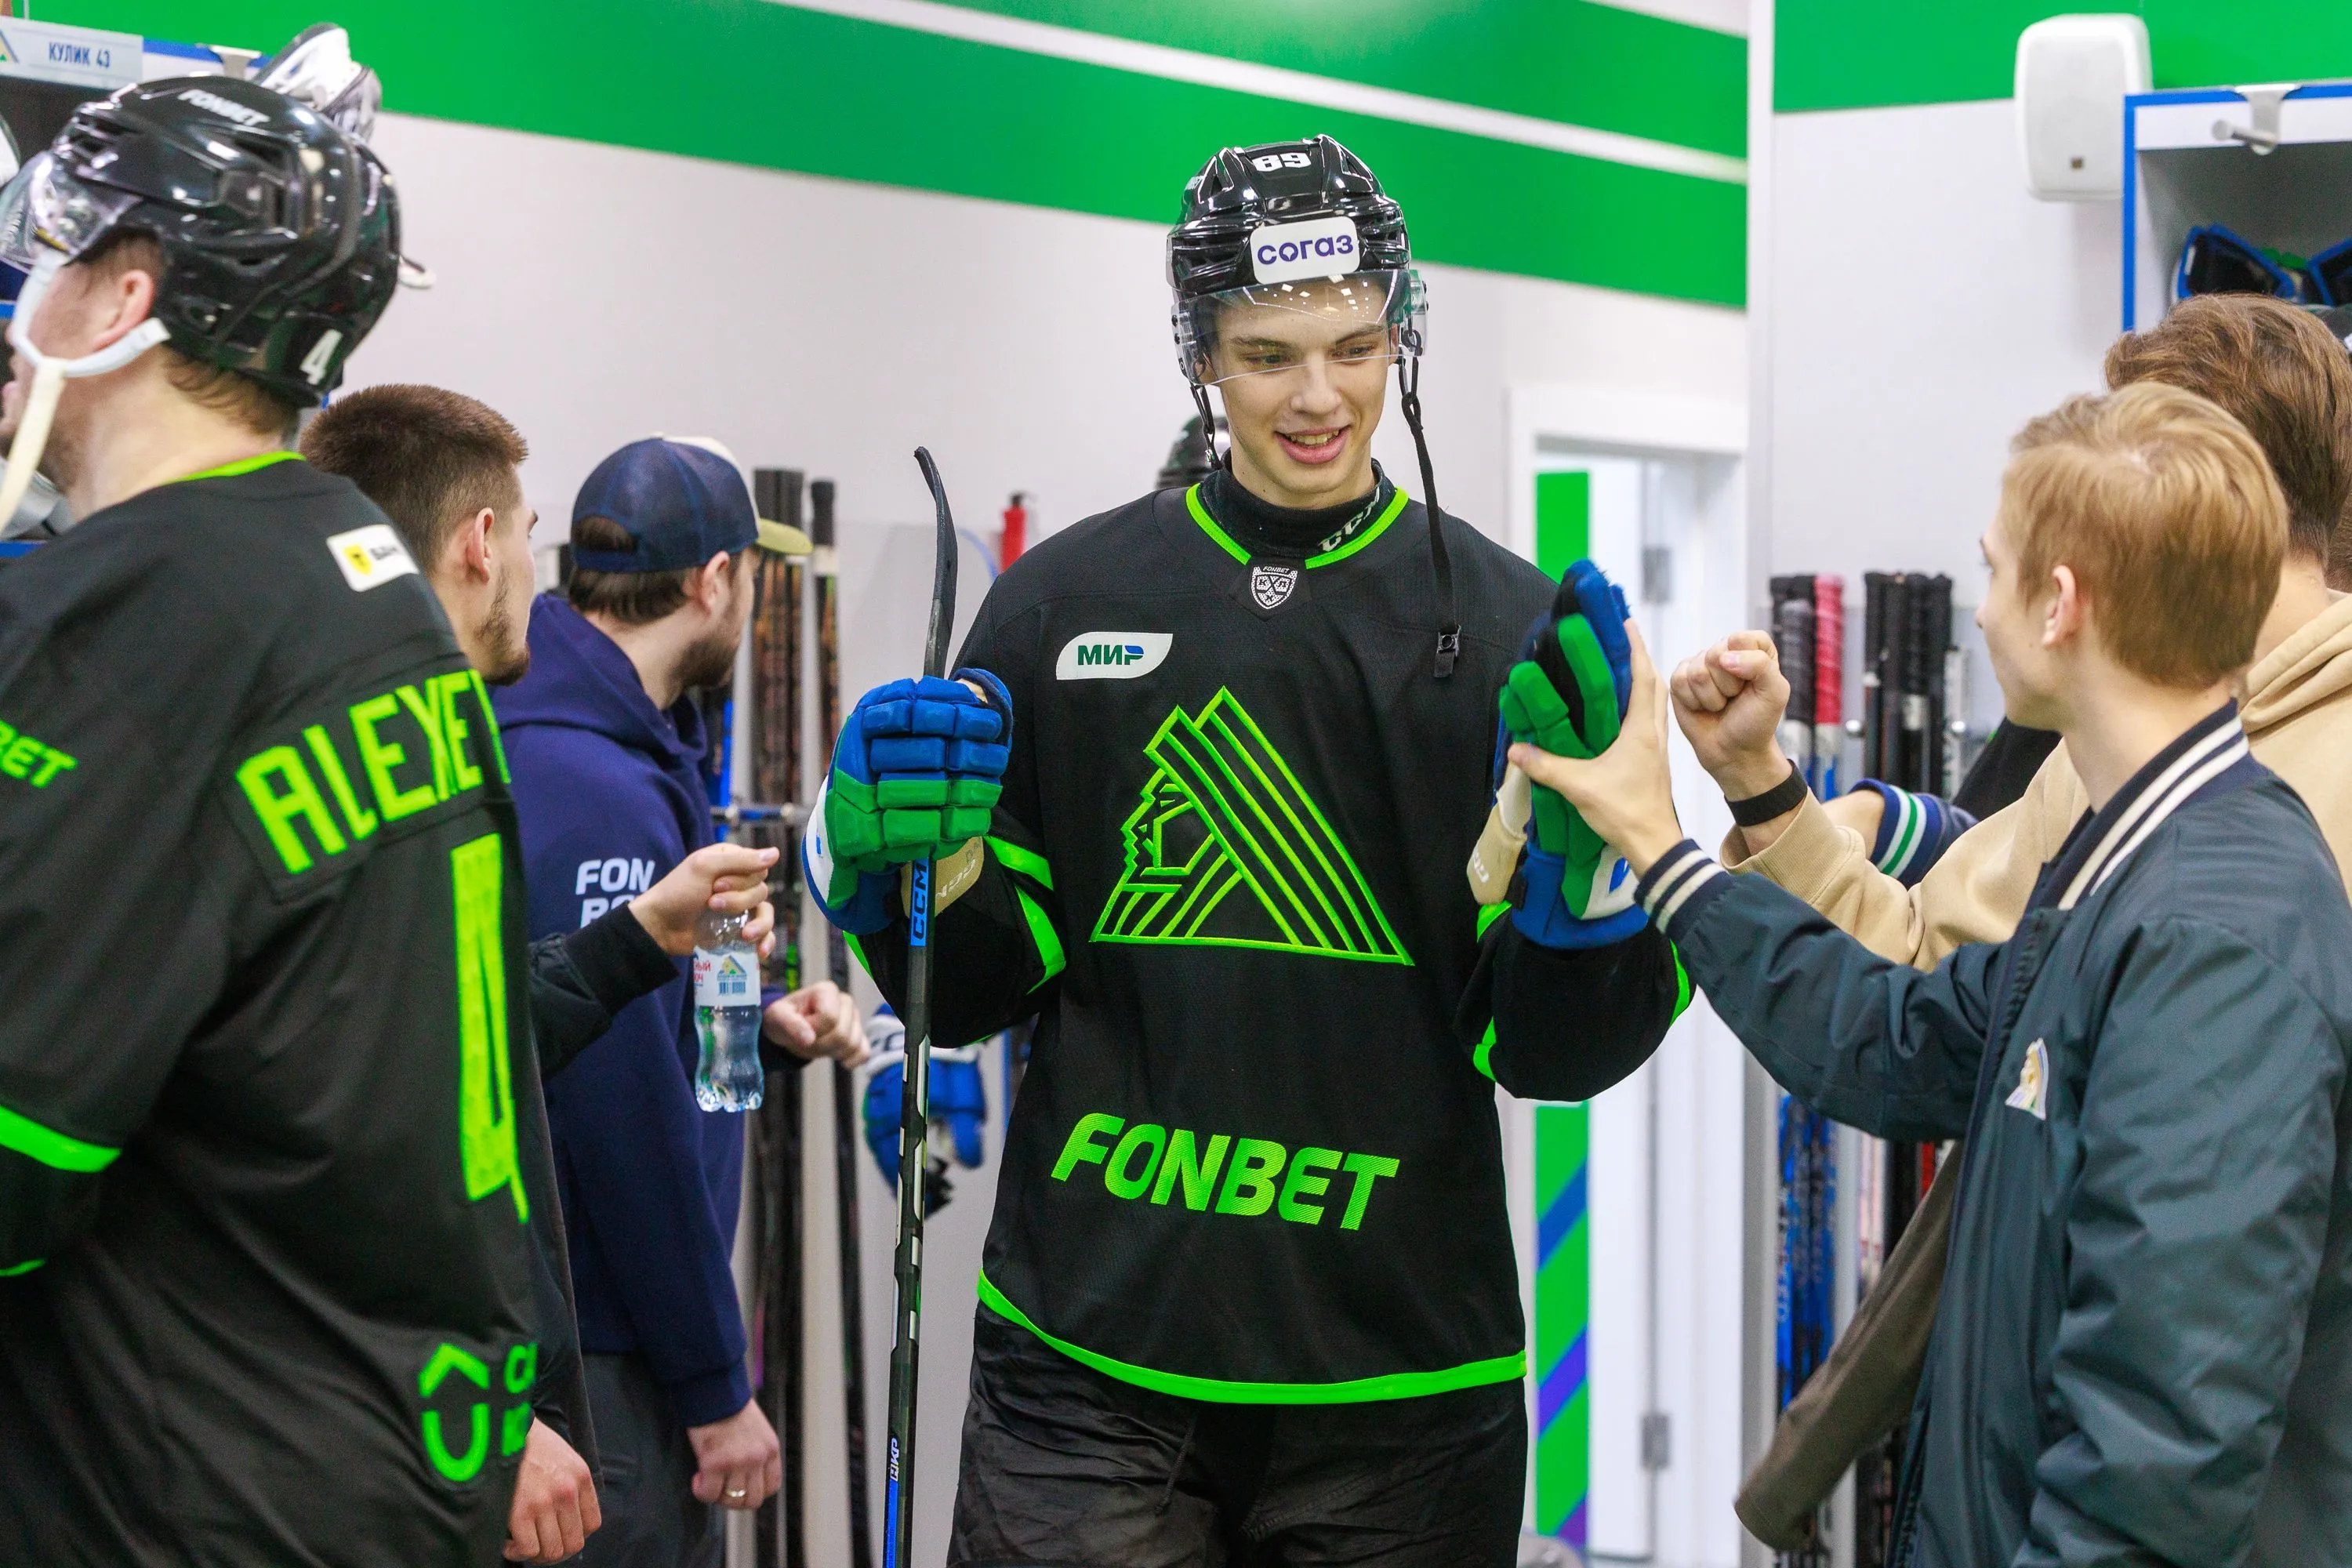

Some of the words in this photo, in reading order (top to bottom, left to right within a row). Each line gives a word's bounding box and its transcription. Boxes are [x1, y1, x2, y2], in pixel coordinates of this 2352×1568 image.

[48, 42, 91, 66] КУЛИК
[96, 49, 111, 69] 43
[1252, 152, 1312, 172] 89
[299, 329, 342, 385] 4
[1077, 644, 1145, 666] МИР
[235, 668, 512, 875] ALEXE
[575, 858, 655, 895] FON
[913, 862, 927, 941] CCM
[1051, 1112, 1400, 1231] FONBET
